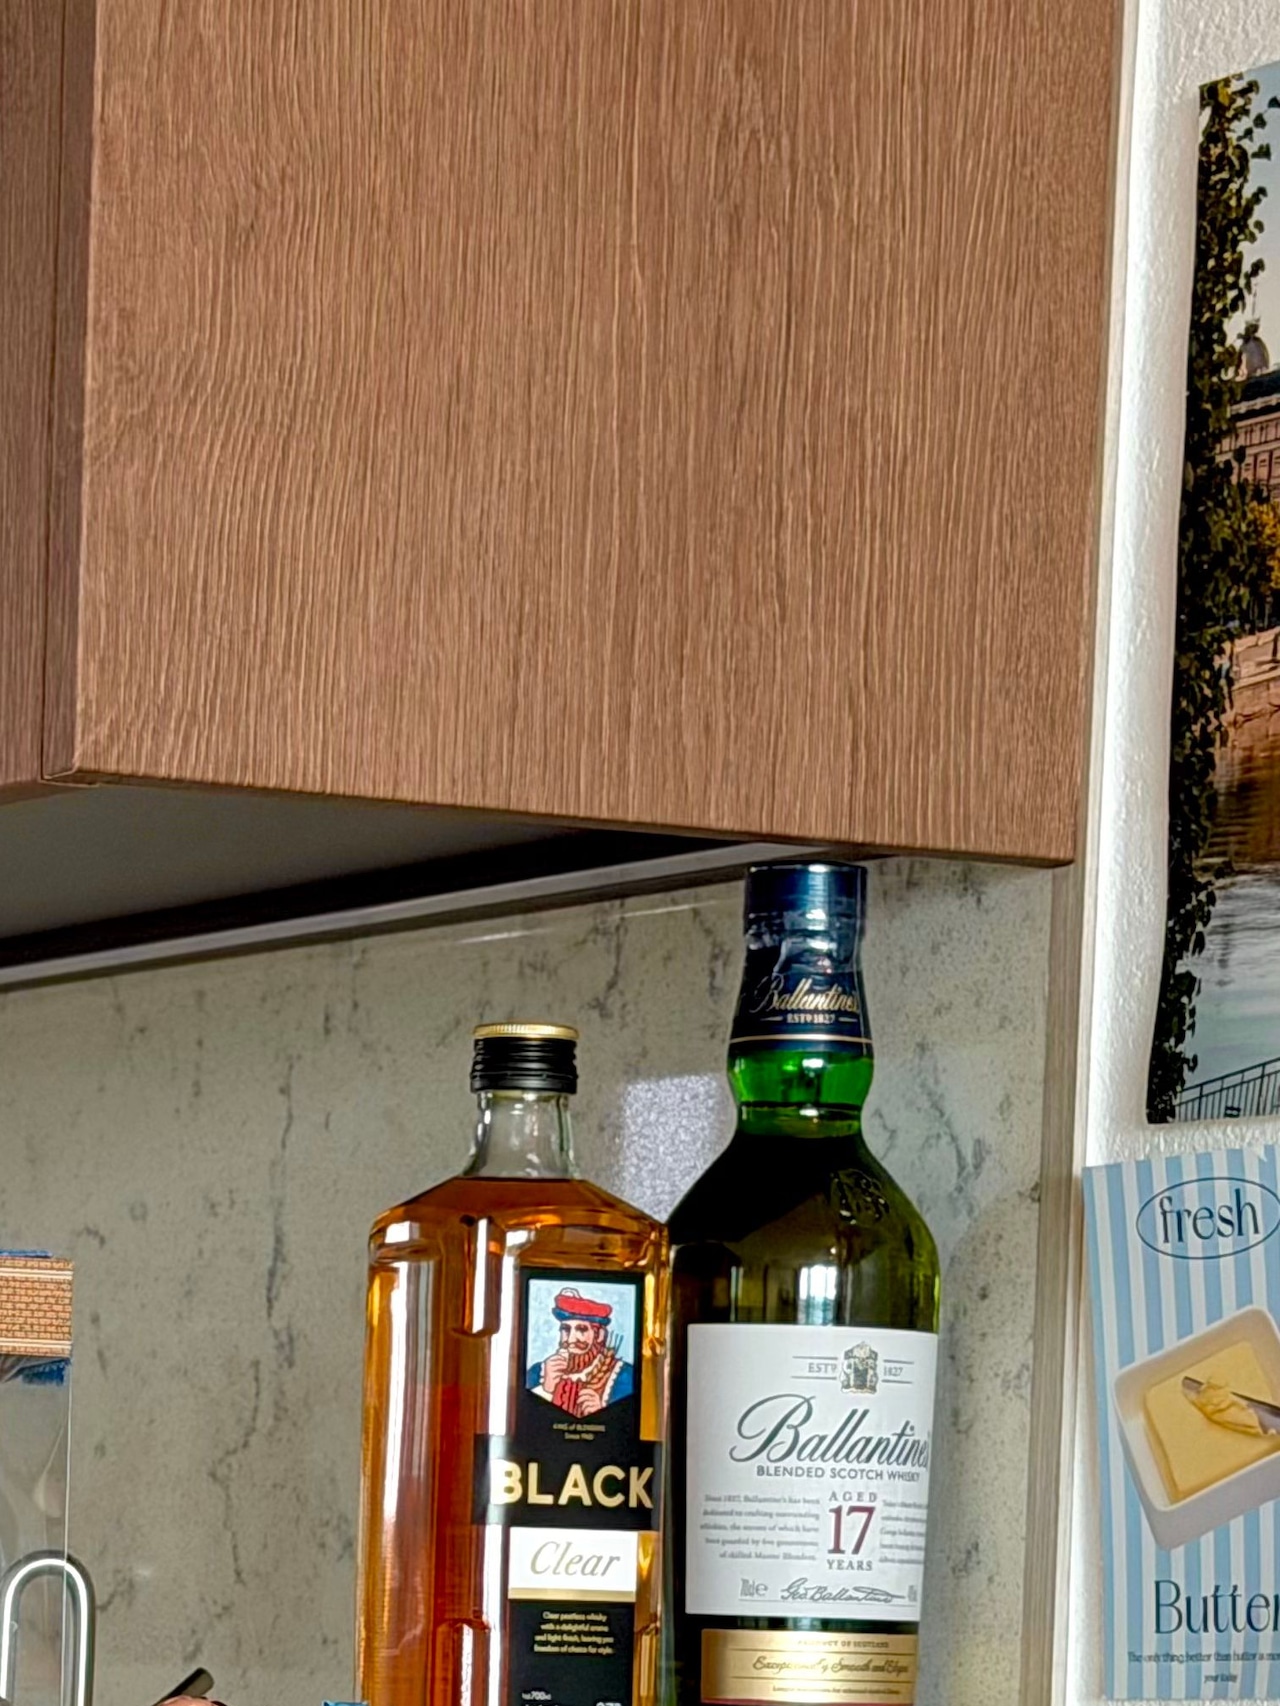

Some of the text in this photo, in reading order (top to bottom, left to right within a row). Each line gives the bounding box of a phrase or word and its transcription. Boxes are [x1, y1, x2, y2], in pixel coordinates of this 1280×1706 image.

[1159, 1189, 1260, 1245] fresh
[883, 1365, 903, 1377] 1827
[490, 1459, 653, 1508] BLACK
[756, 1465, 825, 1478] BLENDED
[830, 1467, 883, 1480] SCOTCH
[828, 1490, 878, 1502] AGED
[827, 1504, 876, 1555] 17
[529, 1540, 622, 1577] Clear
[826, 1559, 872, 1571] YEARS
[1154, 1580, 1280, 1635] Butter
